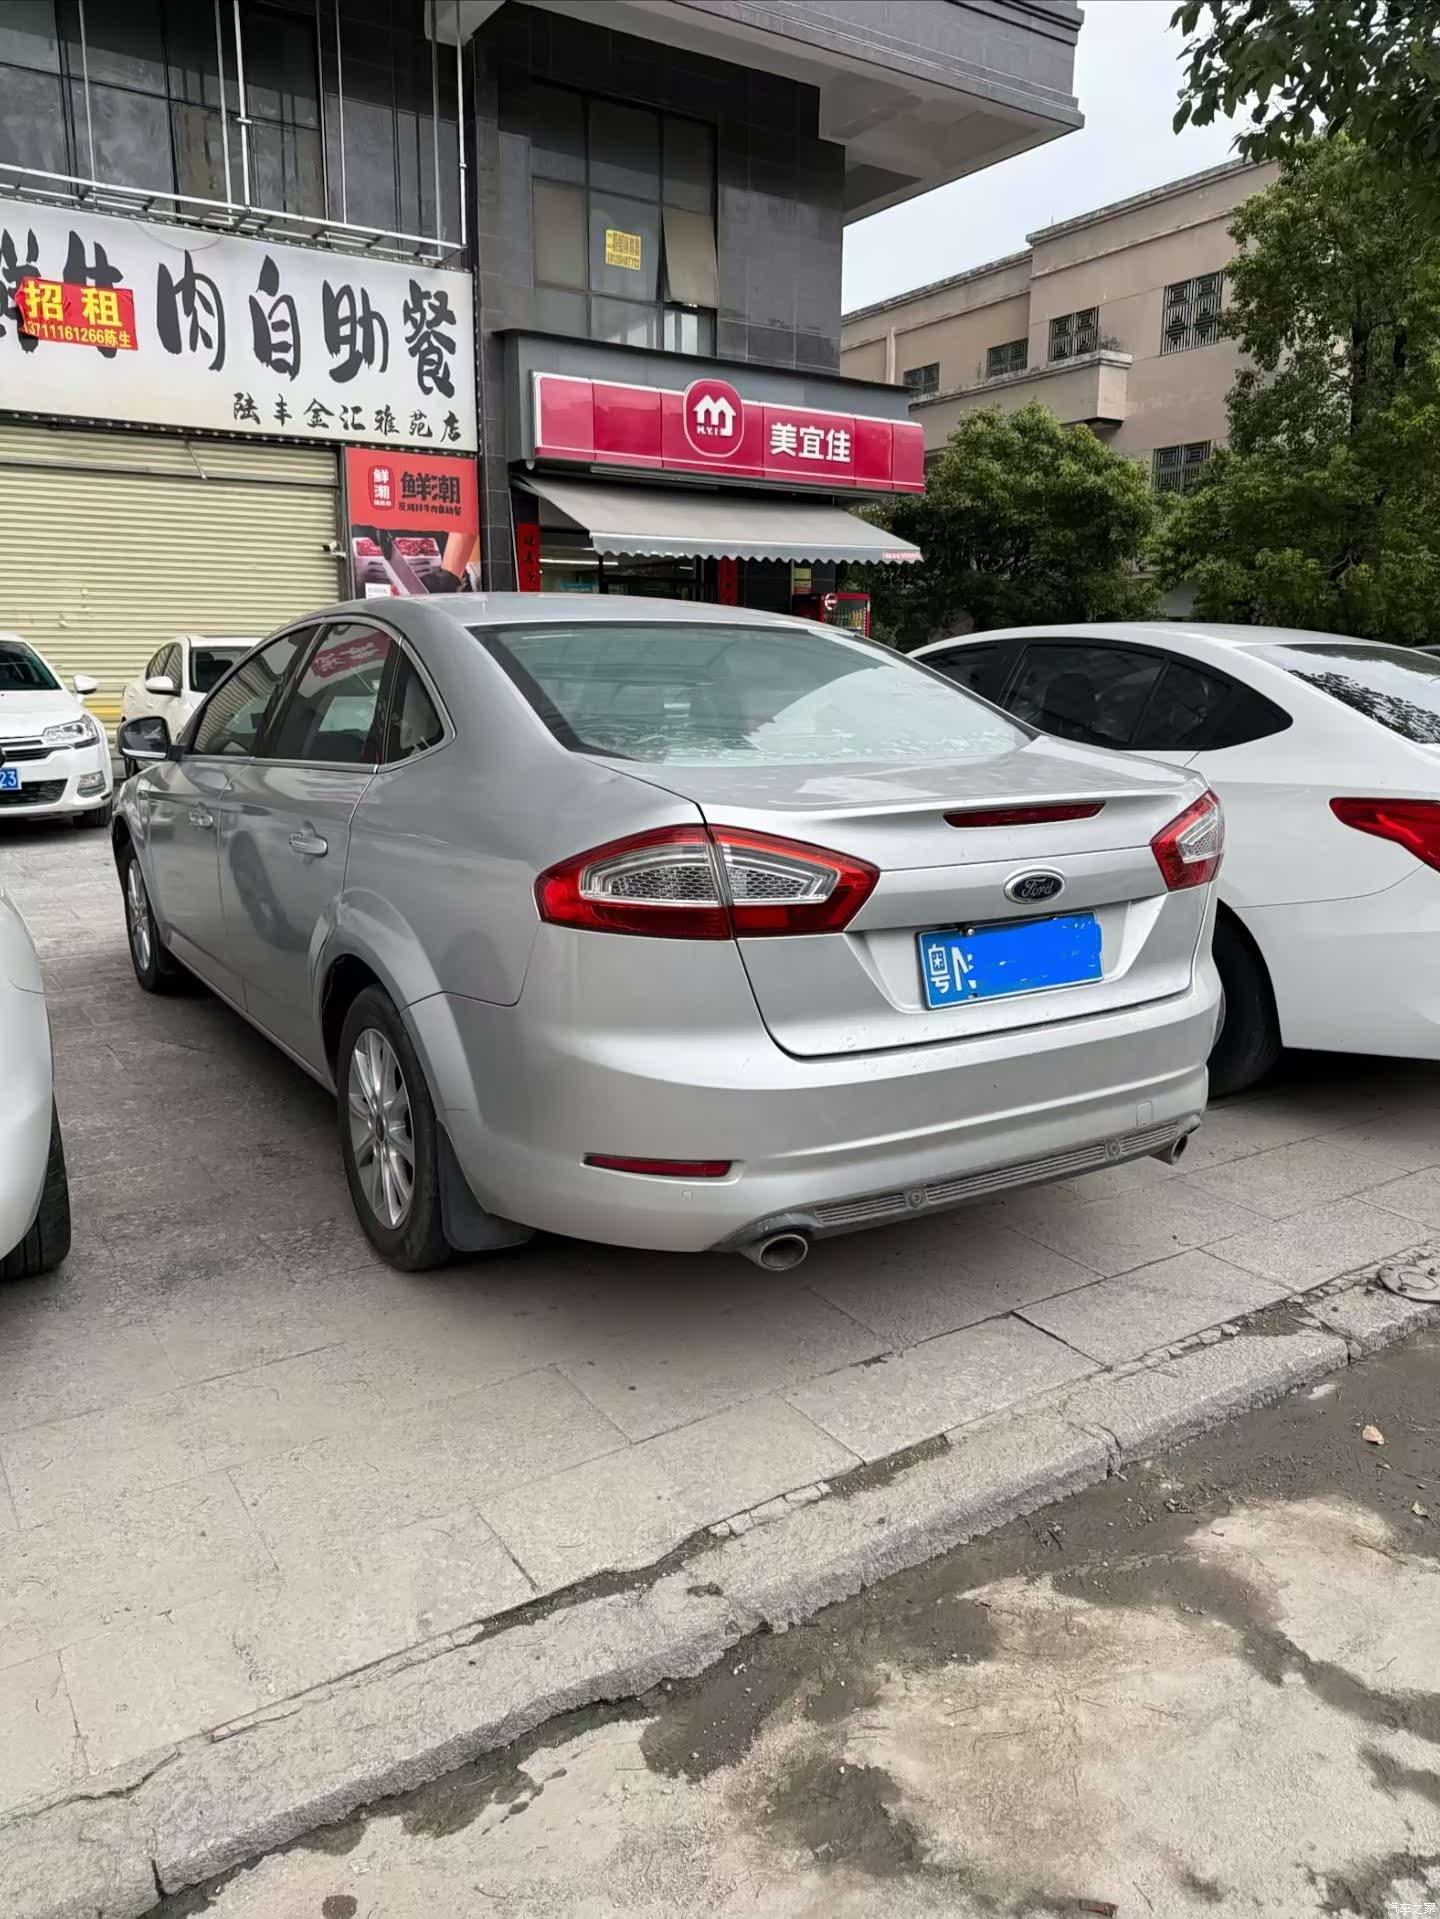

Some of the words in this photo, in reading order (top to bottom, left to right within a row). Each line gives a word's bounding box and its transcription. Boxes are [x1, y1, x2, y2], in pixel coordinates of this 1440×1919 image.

[24, 280, 122, 327] 招租
[25, 321, 132, 348] 3711161266陈生
[233, 392, 462, 442] 陆丰金汇雅苑店
[770, 422, 851, 463] 美宜佳
[401, 471, 461, 504] 鲜潮
[1021, 878, 1055, 898] Ford
